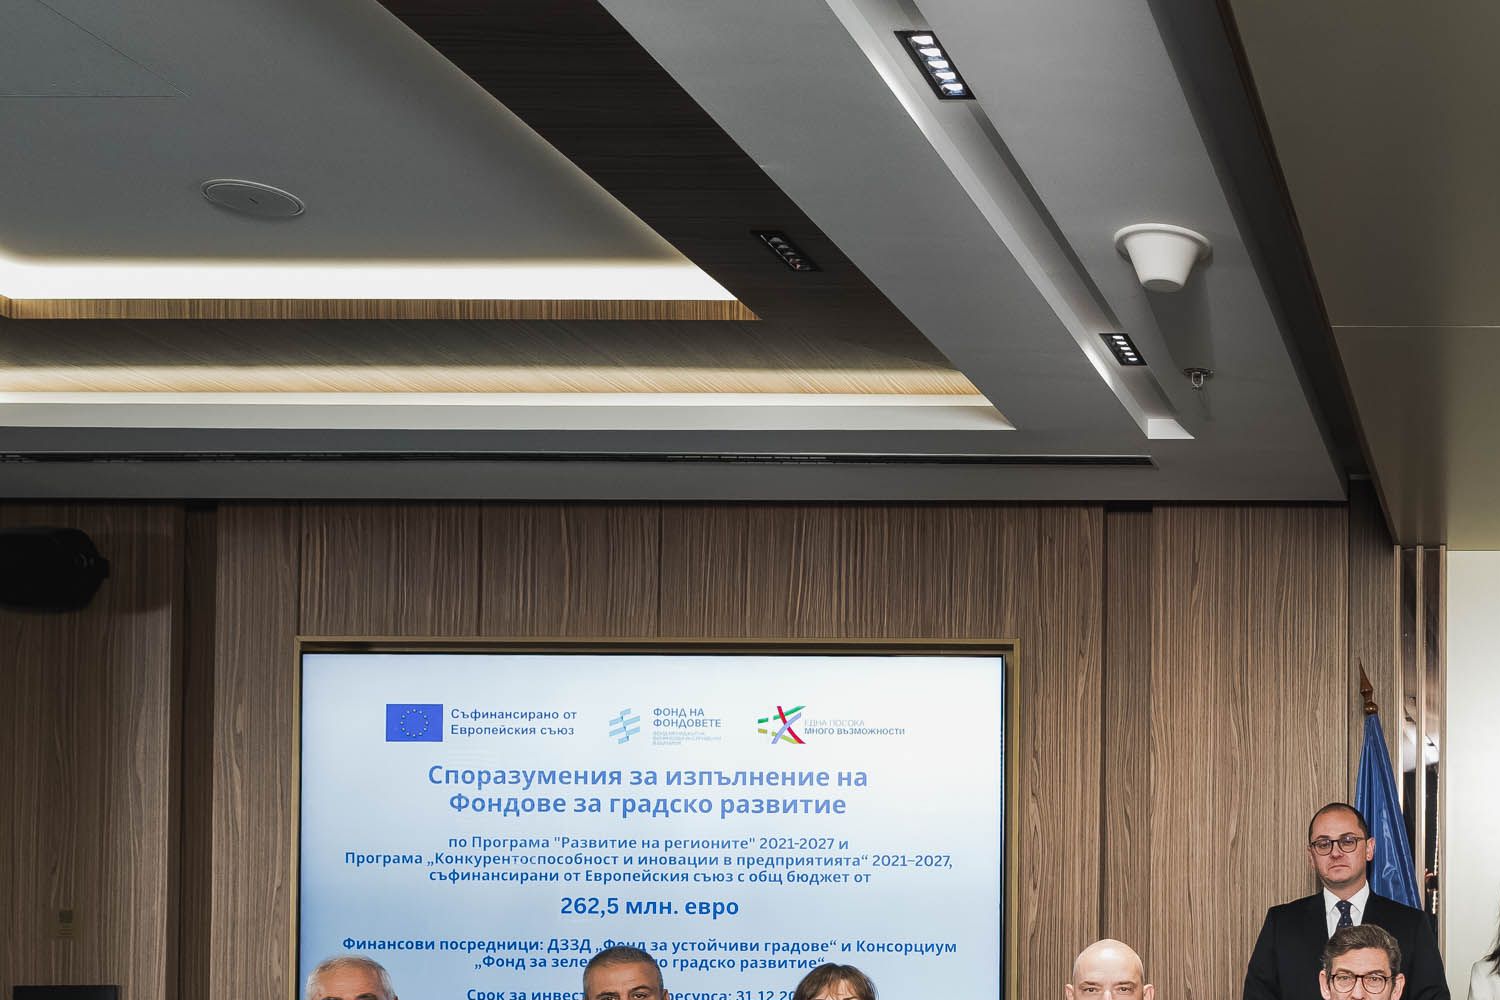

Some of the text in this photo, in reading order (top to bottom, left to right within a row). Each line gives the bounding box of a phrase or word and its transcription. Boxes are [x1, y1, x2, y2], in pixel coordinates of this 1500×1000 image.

[450, 708, 577, 722] Съфинансирано от
[653, 707, 705, 719] ФОНД НА
[450, 724, 575, 737] Европейския съюз
[652, 718, 721, 729] ФОНДОВЕТЕ
[804, 727, 905, 736] МНОГО ВЪЗМОЖНОСТИ
[428, 765, 868, 791] Споразумения за изпълнение на
[449, 792, 846, 820] Фондове за градско развитие
[448, 836, 849, 853] по Програма "Развитие на регионите" 2021-2027 и
[345, 851, 423, 868] Програма
[623, 855, 633, 865] и
[637, 855, 719, 869] иновации
[723, 856, 732, 866] в
[429, 868, 872, 886] съфинансирани от Европейския съюз с общ бюджет от
[560, 897, 739, 921] 262,5 млн. евро
[342, 937, 435, 951] Финансови
[439, 940, 544, 954] посредници:
[546, 938, 592, 954] ДЗЗД
[649, 941, 668, 952] за
[671, 938, 760, 955] устойчиви
[841, 942, 852, 953] и
[856, 940, 957, 957] Консорциум
[529, 957, 547, 968] за
[551, 958, 588, 968] зеле
[672, 958, 736, 972] градско
